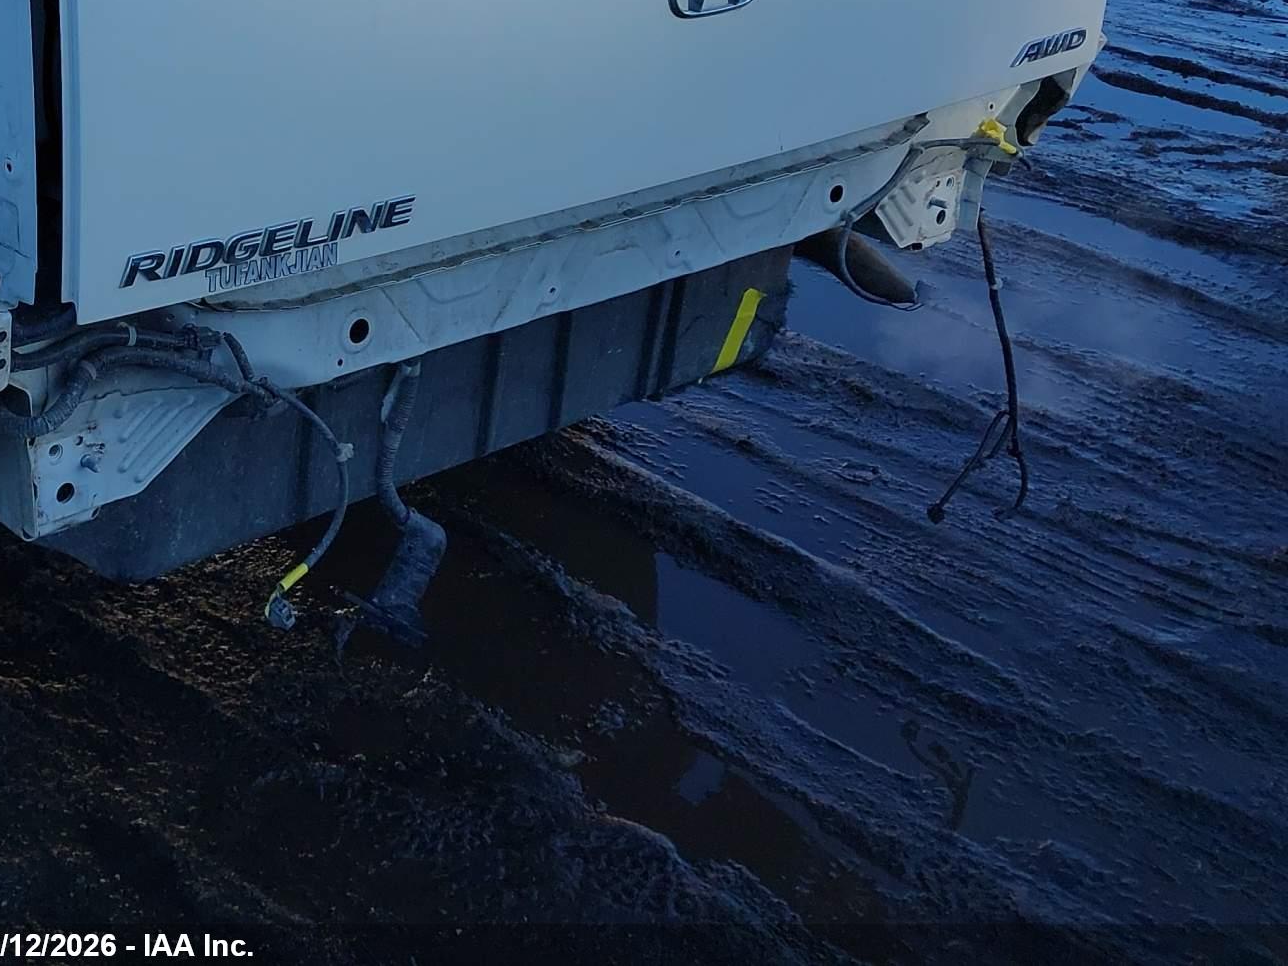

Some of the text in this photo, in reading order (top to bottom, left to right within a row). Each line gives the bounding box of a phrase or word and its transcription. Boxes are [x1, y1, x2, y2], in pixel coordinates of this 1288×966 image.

[1010, 27, 1087, 68] AWD
[118, 194, 417, 289] RIDGELINE
[205, 242, 339, 293] TUFANKJIAN
